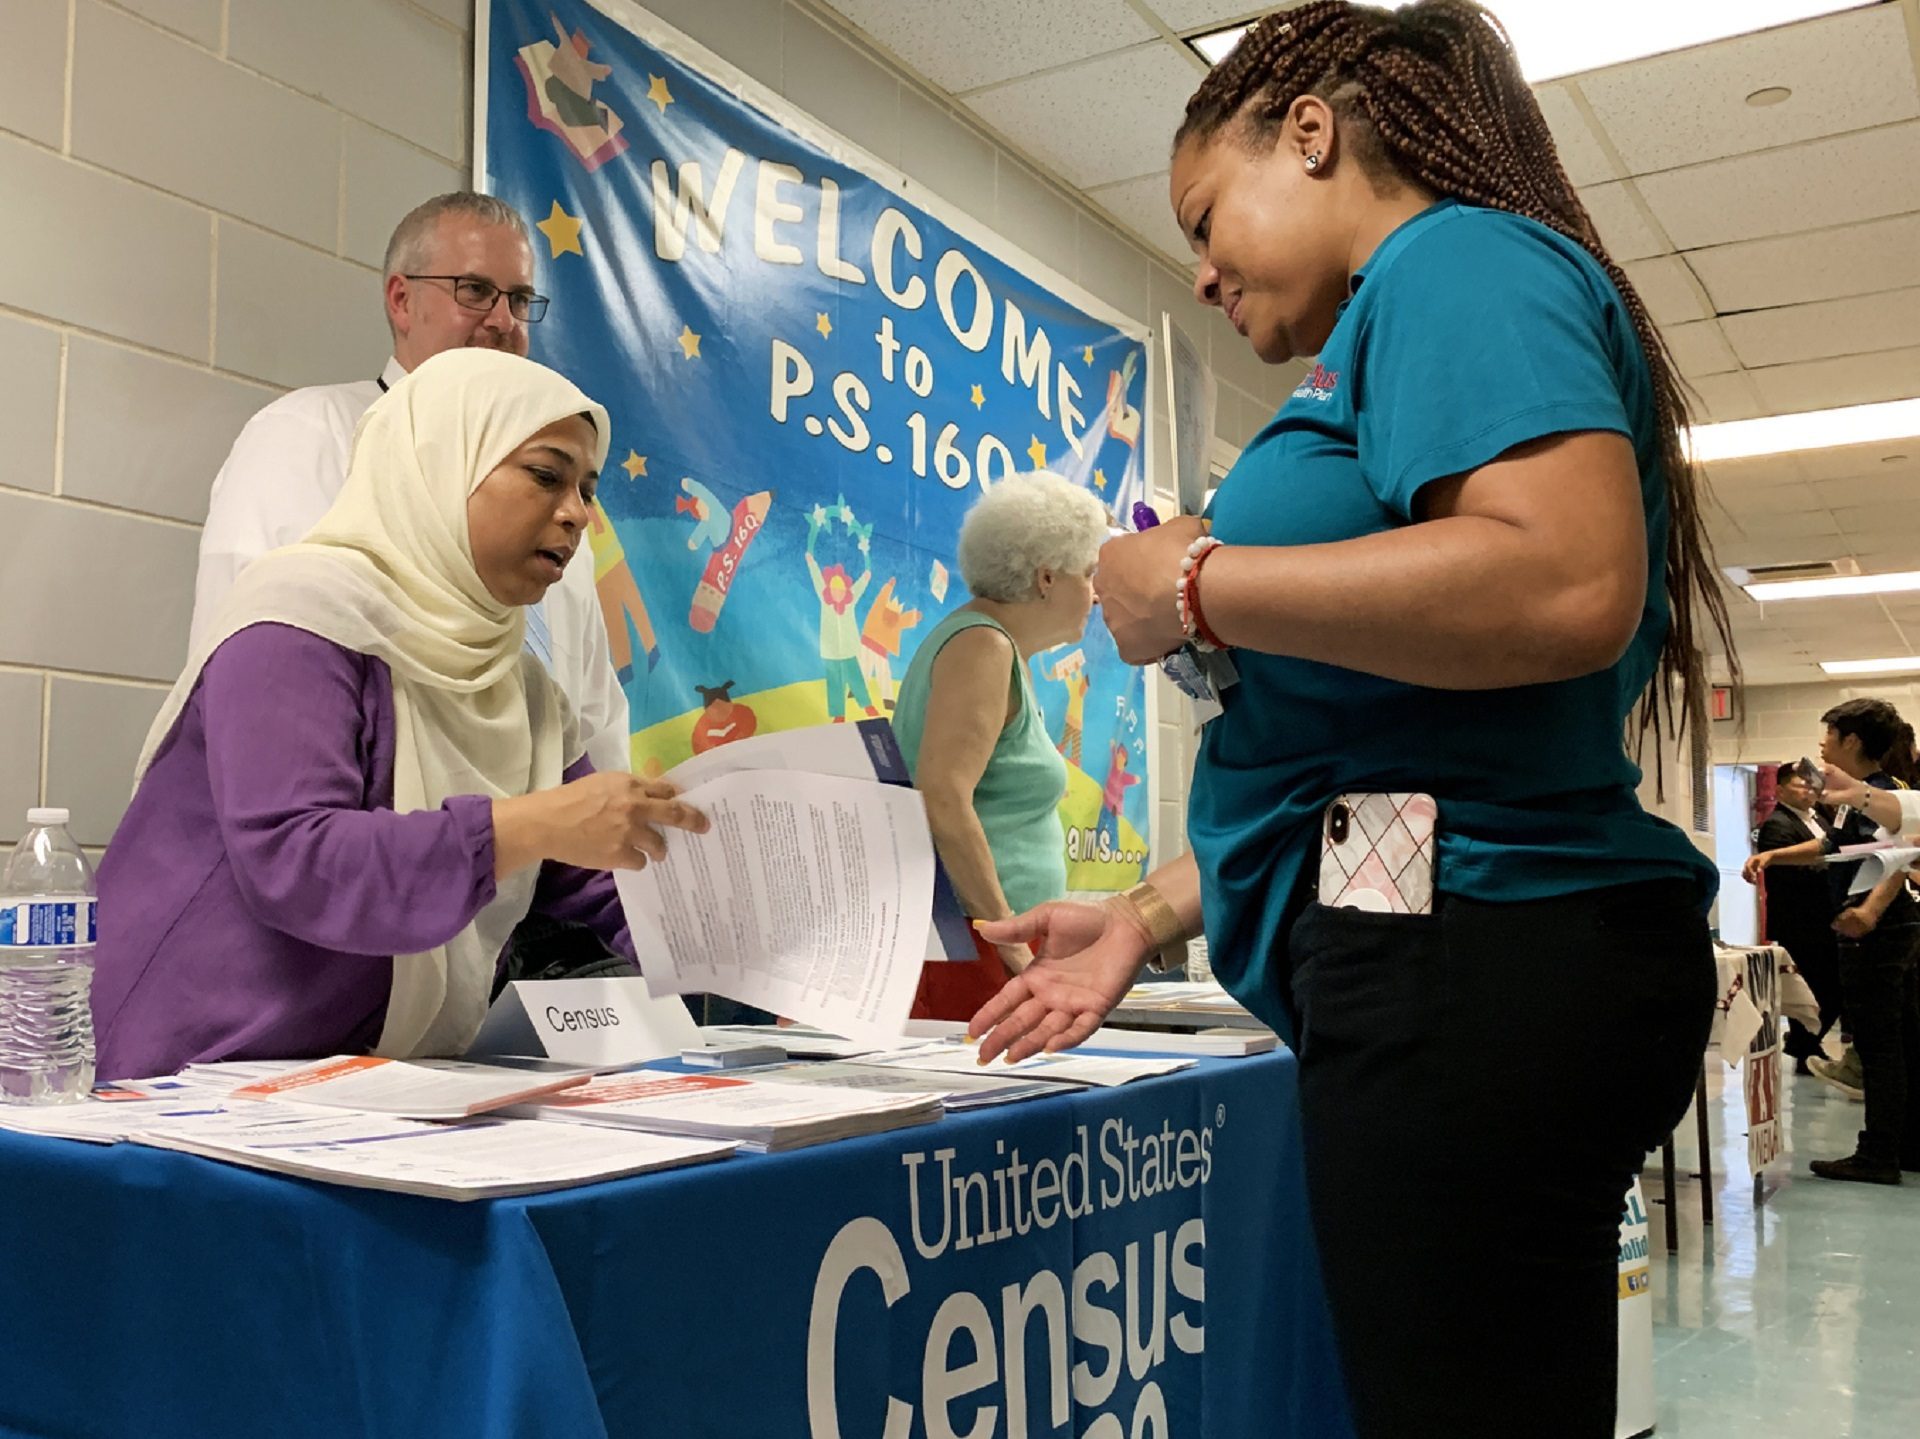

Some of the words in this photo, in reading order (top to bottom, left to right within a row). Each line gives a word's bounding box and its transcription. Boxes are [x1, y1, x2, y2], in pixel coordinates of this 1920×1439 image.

[650, 147, 1086, 461] WELCOME
[874, 315, 934, 398] to
[1066, 825, 1142, 864] ams...
[545, 1006, 620, 1032] Census
[902, 1124, 1094, 1260] United
[807, 1216, 1206, 1439] Census
